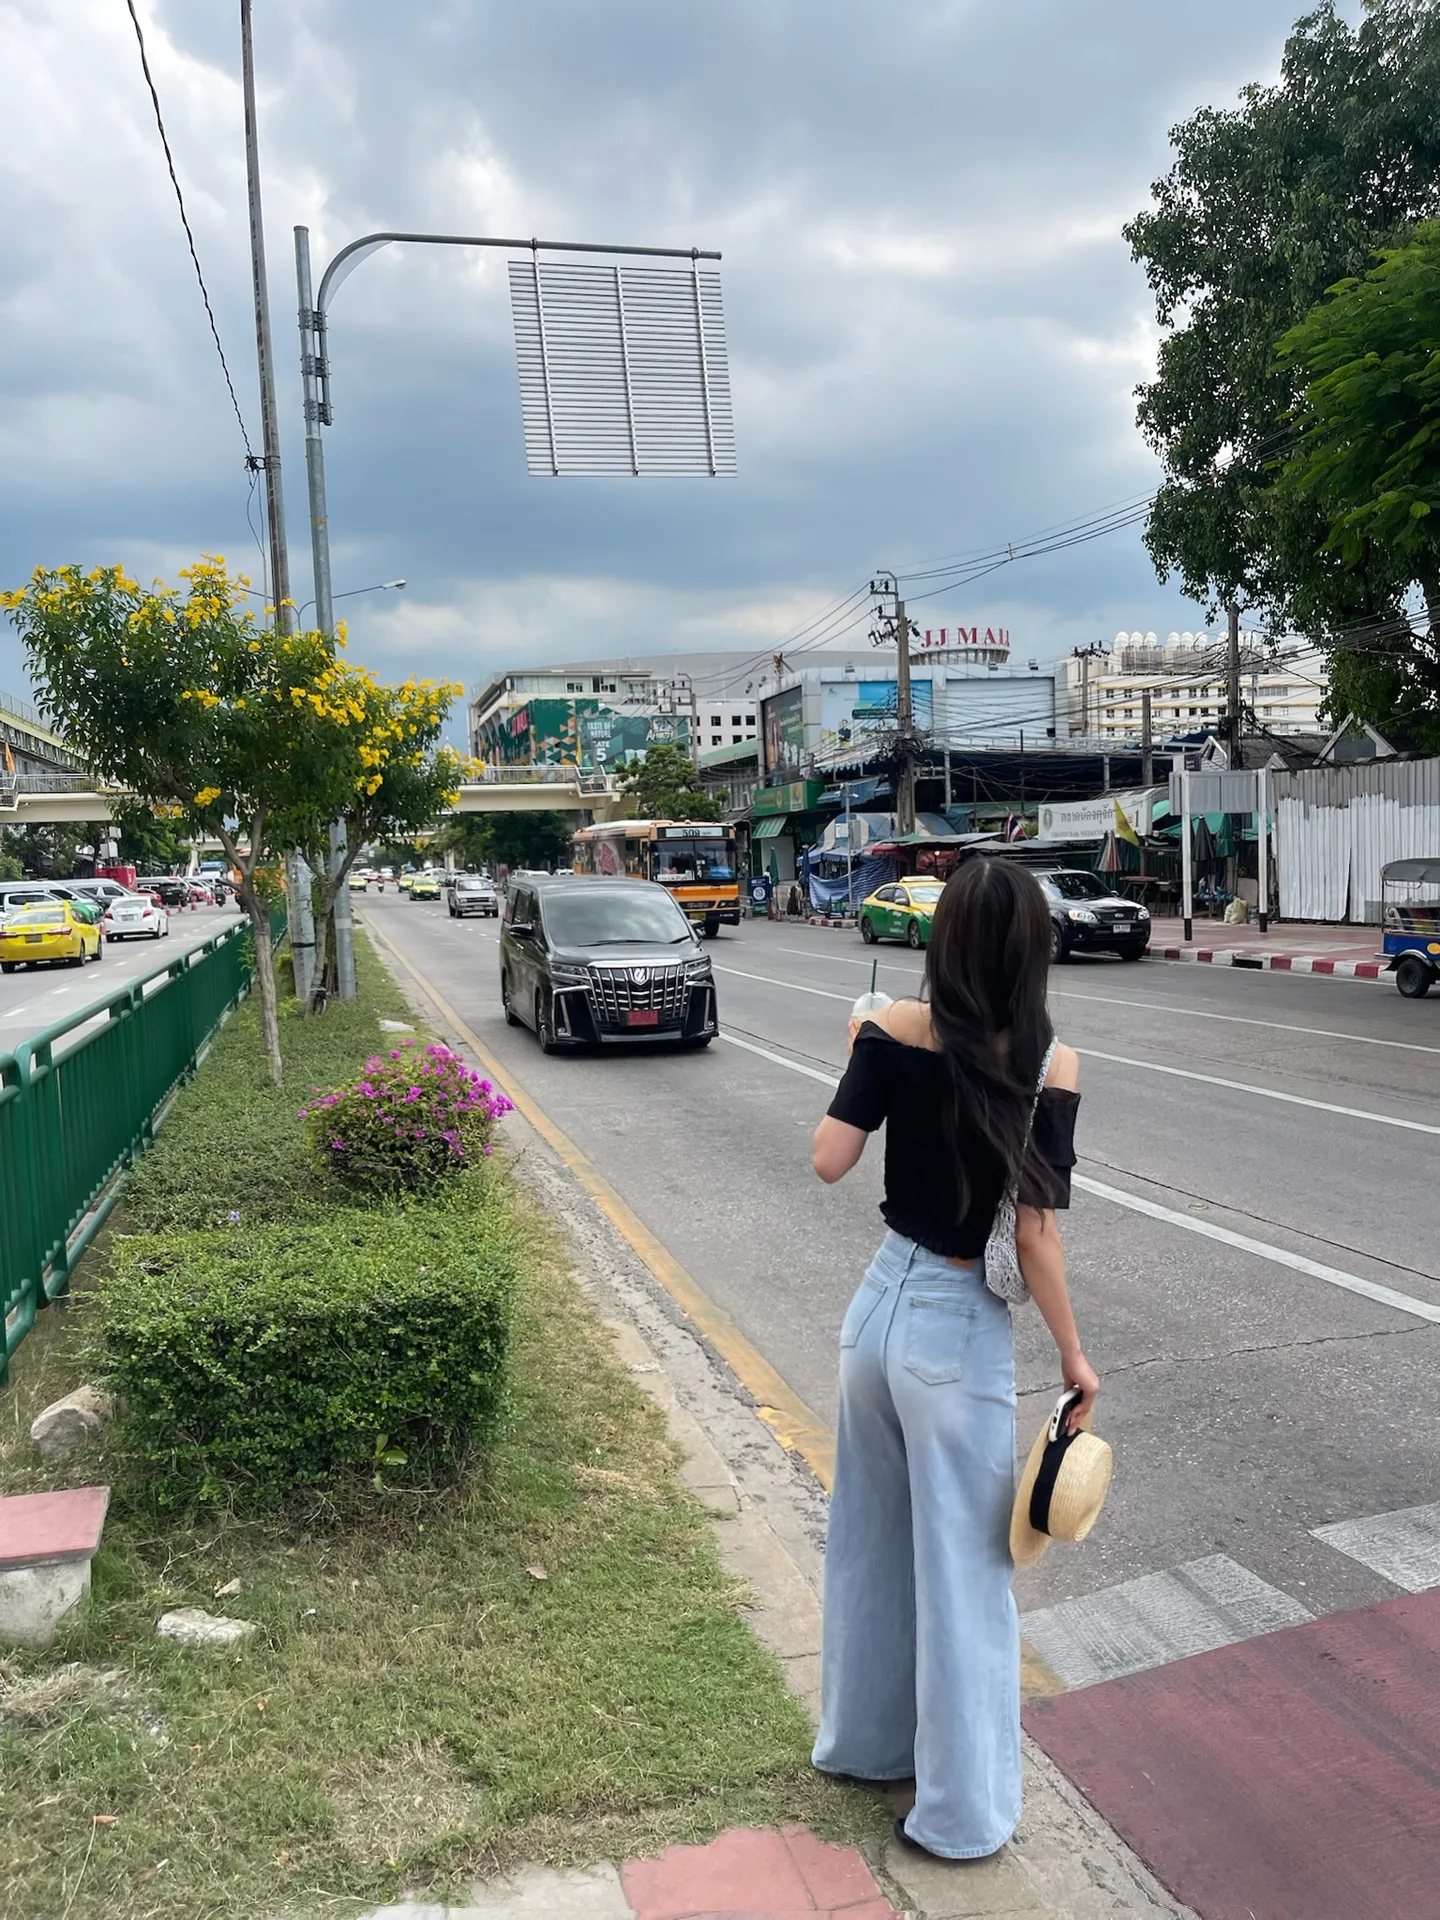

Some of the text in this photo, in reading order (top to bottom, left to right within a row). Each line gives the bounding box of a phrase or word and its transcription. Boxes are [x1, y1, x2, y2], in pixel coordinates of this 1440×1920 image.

[921, 627, 947, 648] JJ
[587, 721, 603, 730] TASTE
[596, 747, 607, 762] 5
[1060, 803, 1114, 825] ตลาดนัดจตุจัก
[1134, 809, 1140, 827] 1
[682, 828, 700, 837] 509
